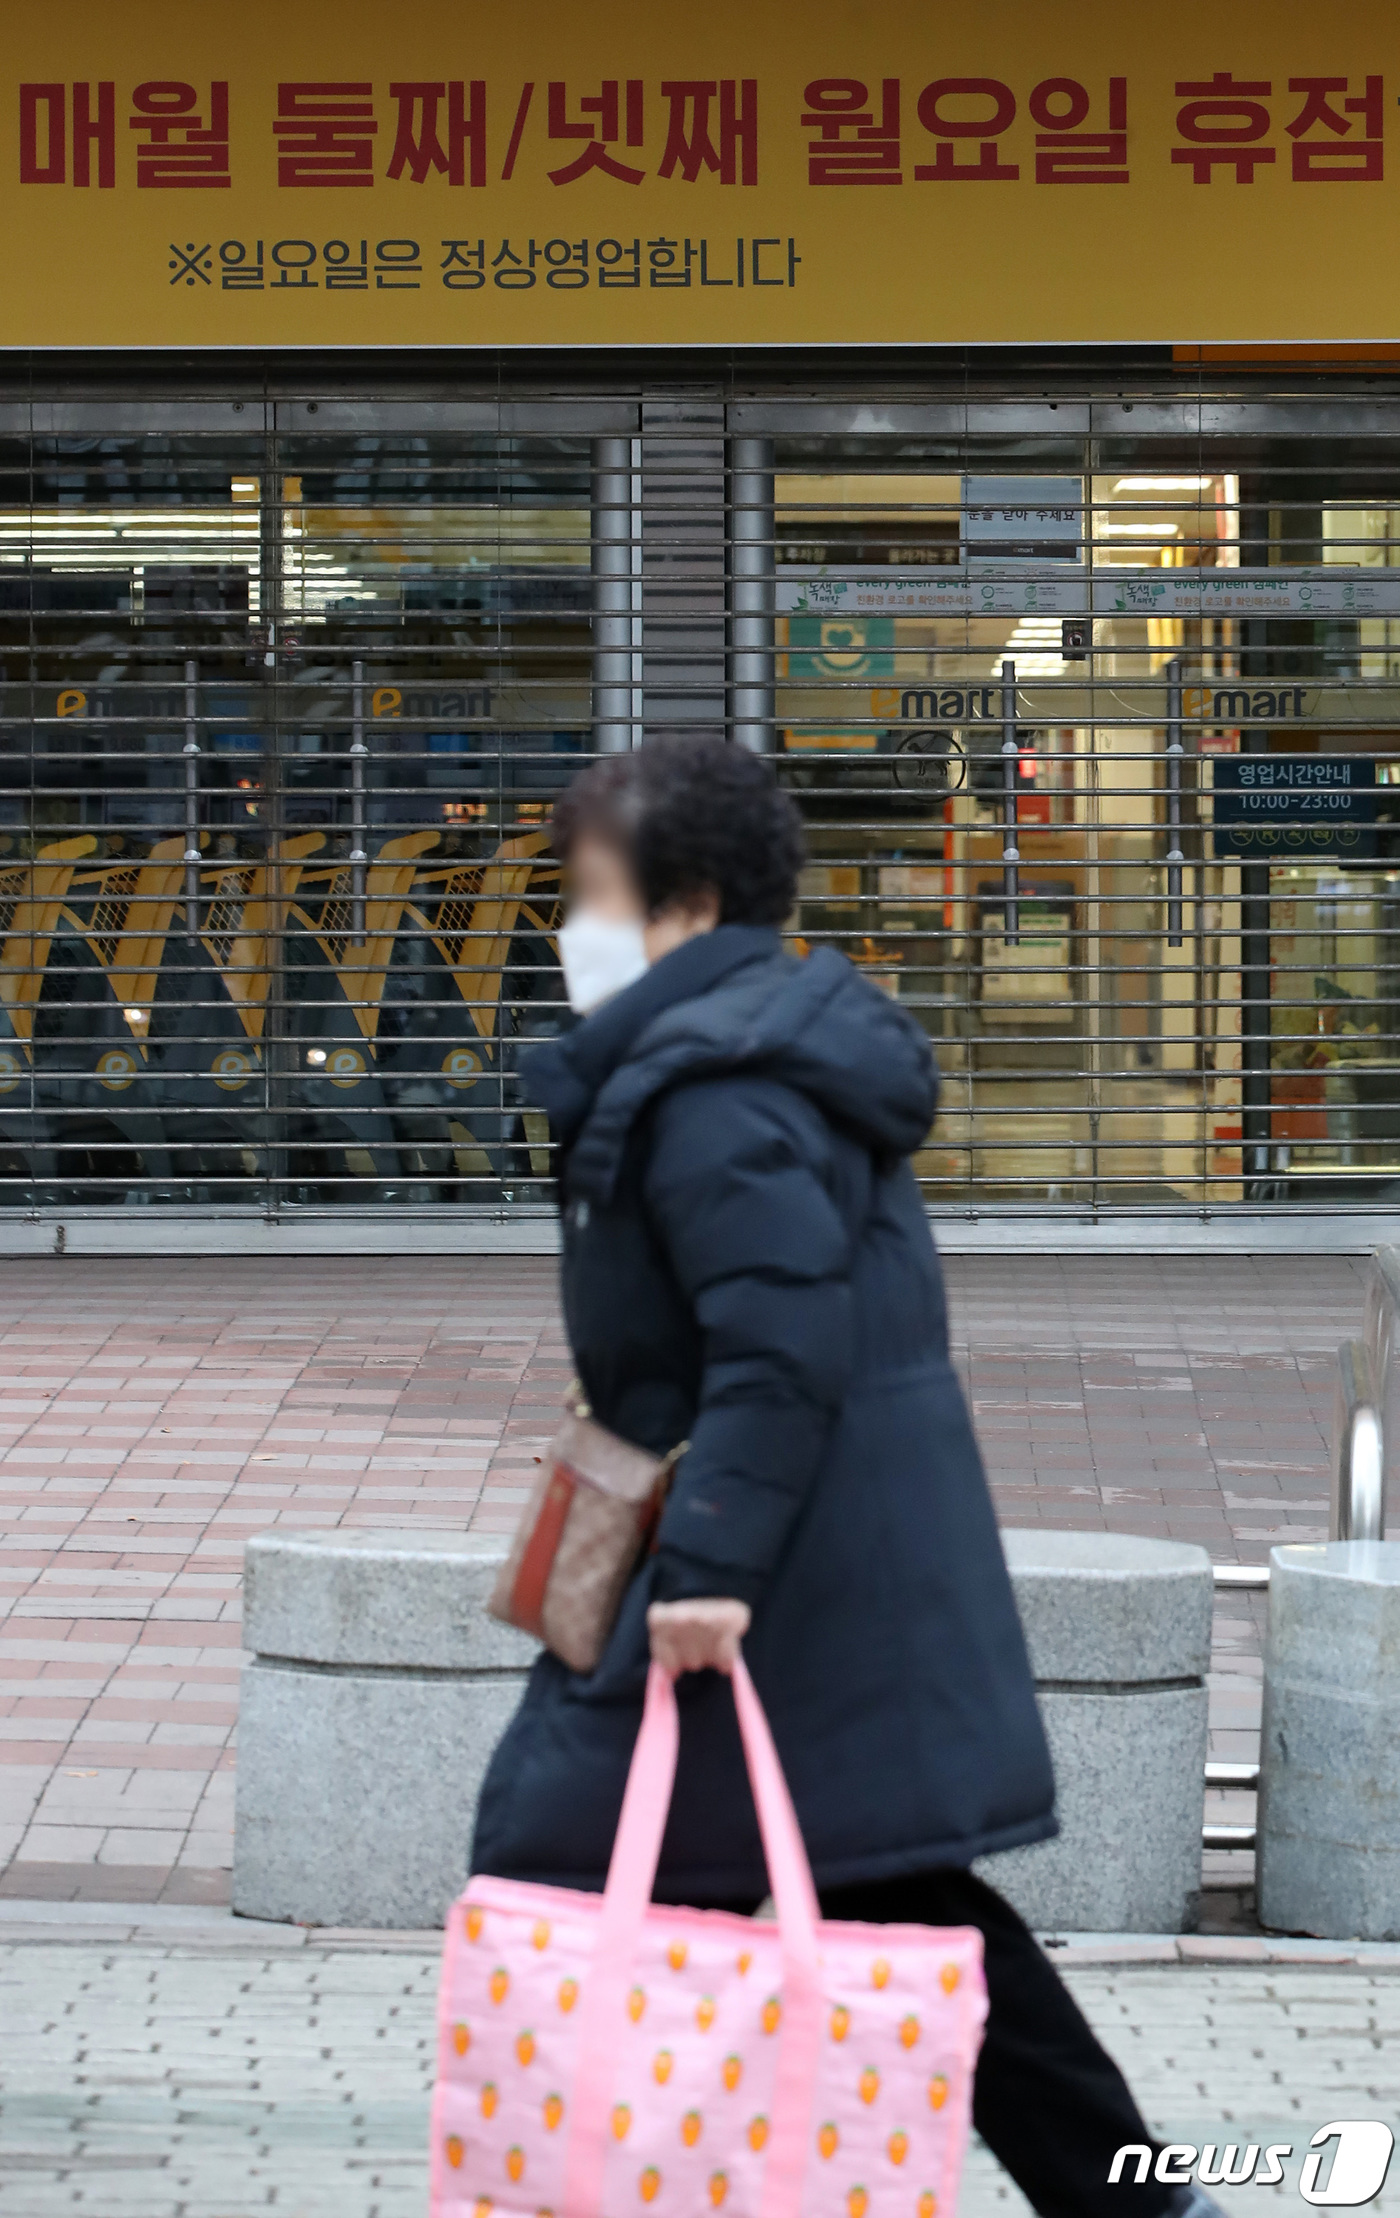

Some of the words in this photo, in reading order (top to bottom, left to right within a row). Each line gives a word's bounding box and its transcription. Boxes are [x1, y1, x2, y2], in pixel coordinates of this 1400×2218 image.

[19, 80, 232, 189] 매월
[272, 78, 758, 188] 둘째/넷째
[800, 76, 1130, 187] 월요일
[1170, 71, 1384, 185] 휴점
[439, 236, 802, 290] 정상영업합니다
[372, 688, 496, 718] emart
[870, 688, 994, 719] emart
[1182, 688, 1307, 718] emart
[1237, 762, 1352, 786] 영업시간안내
[1238, 795, 1352, 810] 10:00-23:00
